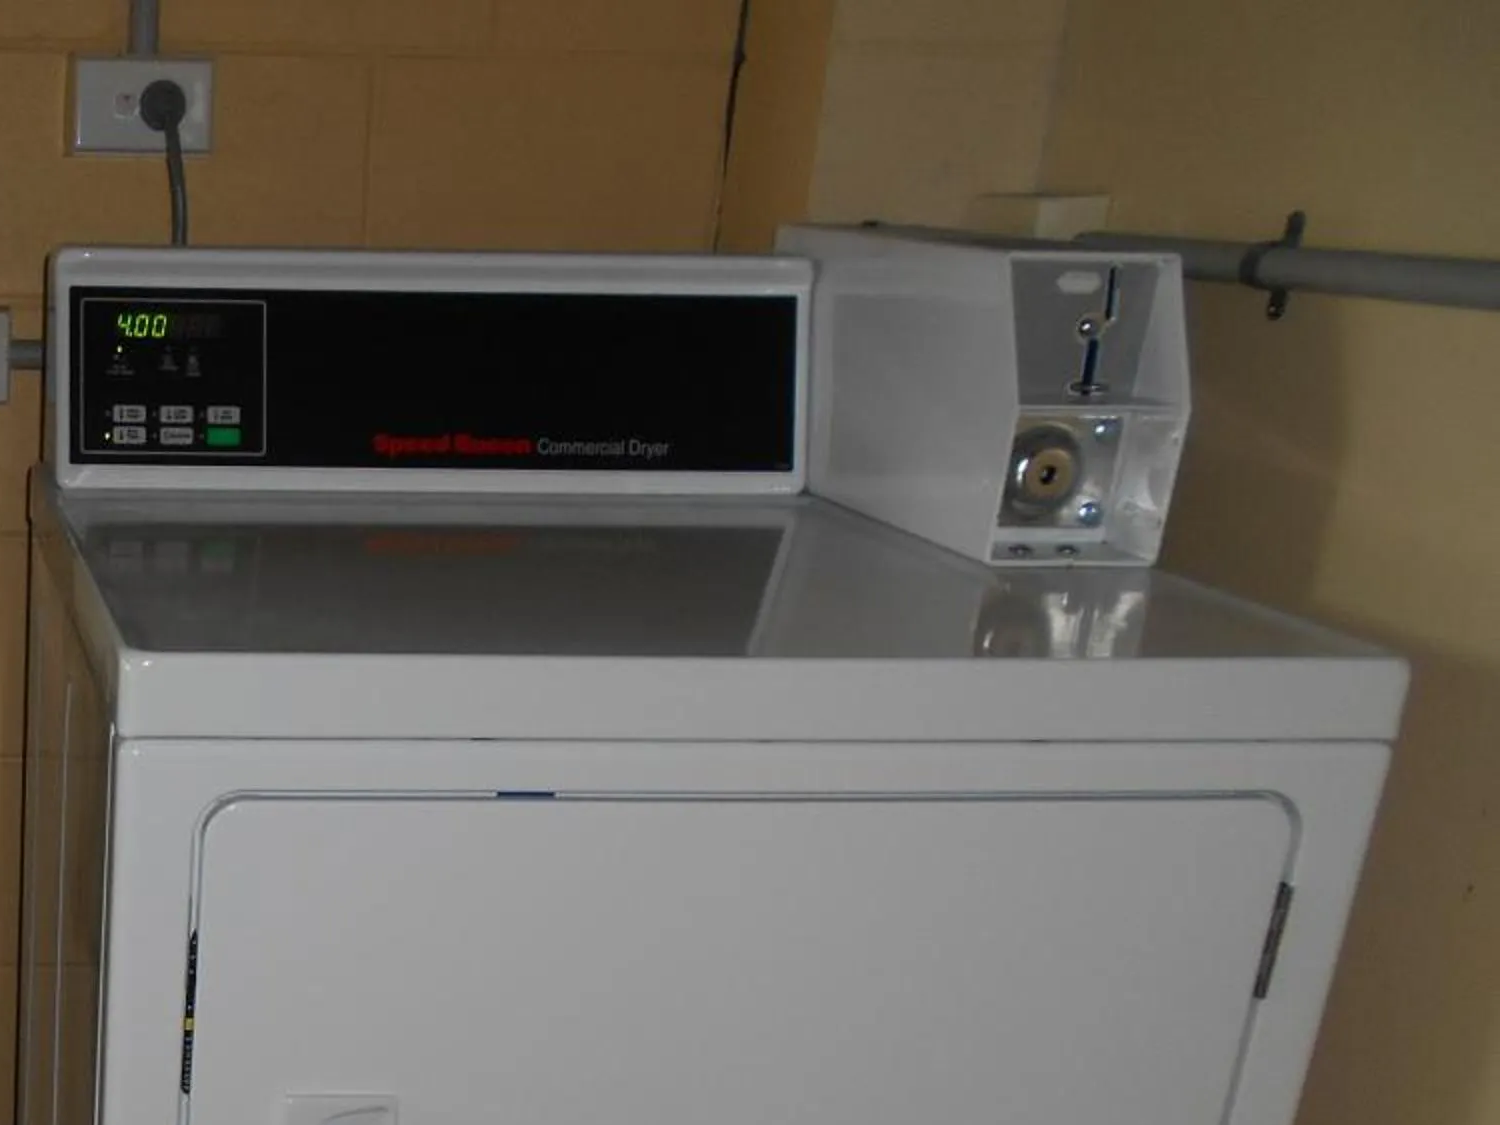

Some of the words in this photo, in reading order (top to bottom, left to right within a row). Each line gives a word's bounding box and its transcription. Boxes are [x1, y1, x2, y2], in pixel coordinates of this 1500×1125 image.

[117, 313, 168, 338] 4.00
[537, 437, 625, 456] Commercial
[629, 439, 670, 460] Dryer
